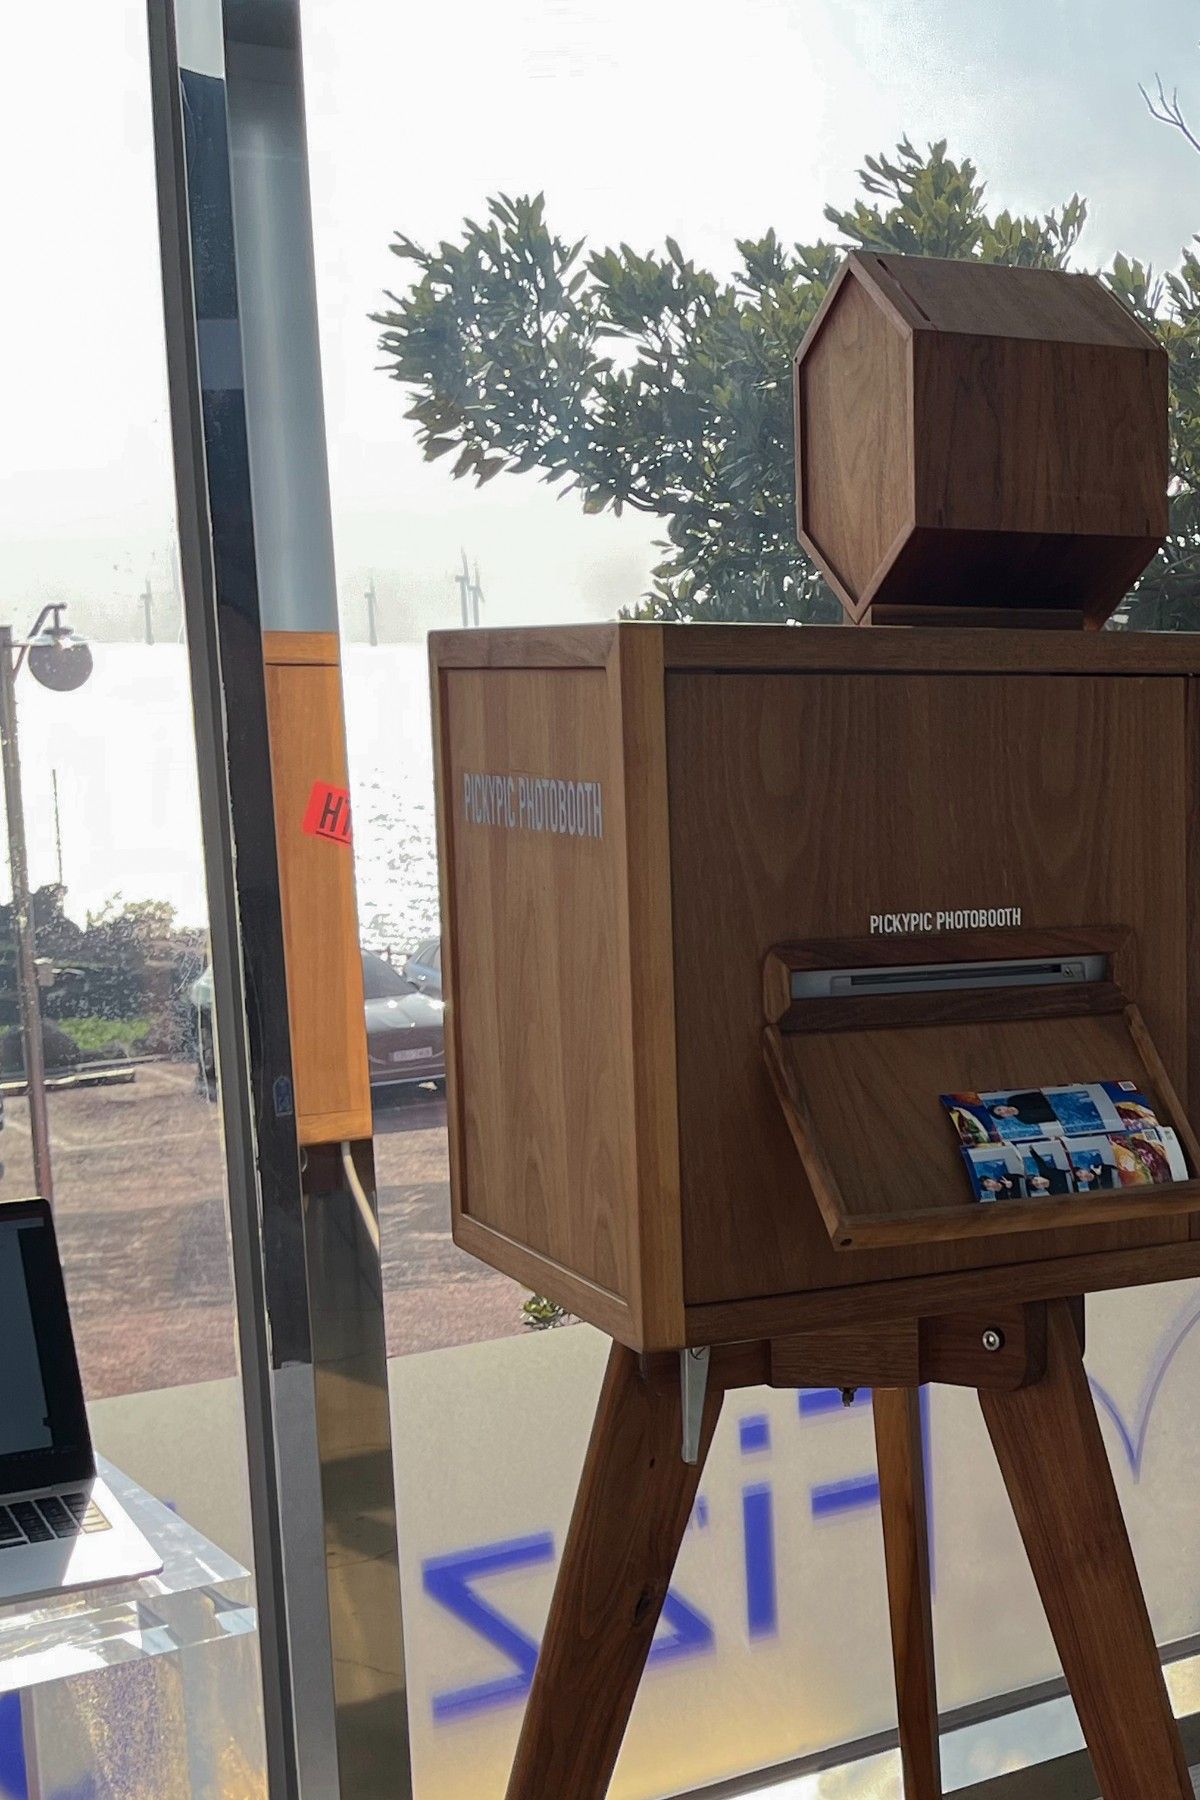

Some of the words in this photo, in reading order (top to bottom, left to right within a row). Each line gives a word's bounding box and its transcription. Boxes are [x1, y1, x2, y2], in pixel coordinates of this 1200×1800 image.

[463, 773, 516, 828] PICKYPIC
[518, 776, 603, 839] PHOTOBOOTH
[870, 912, 933, 934] PICKYPIC
[936, 907, 1022, 930] PHOTOBOOTH
